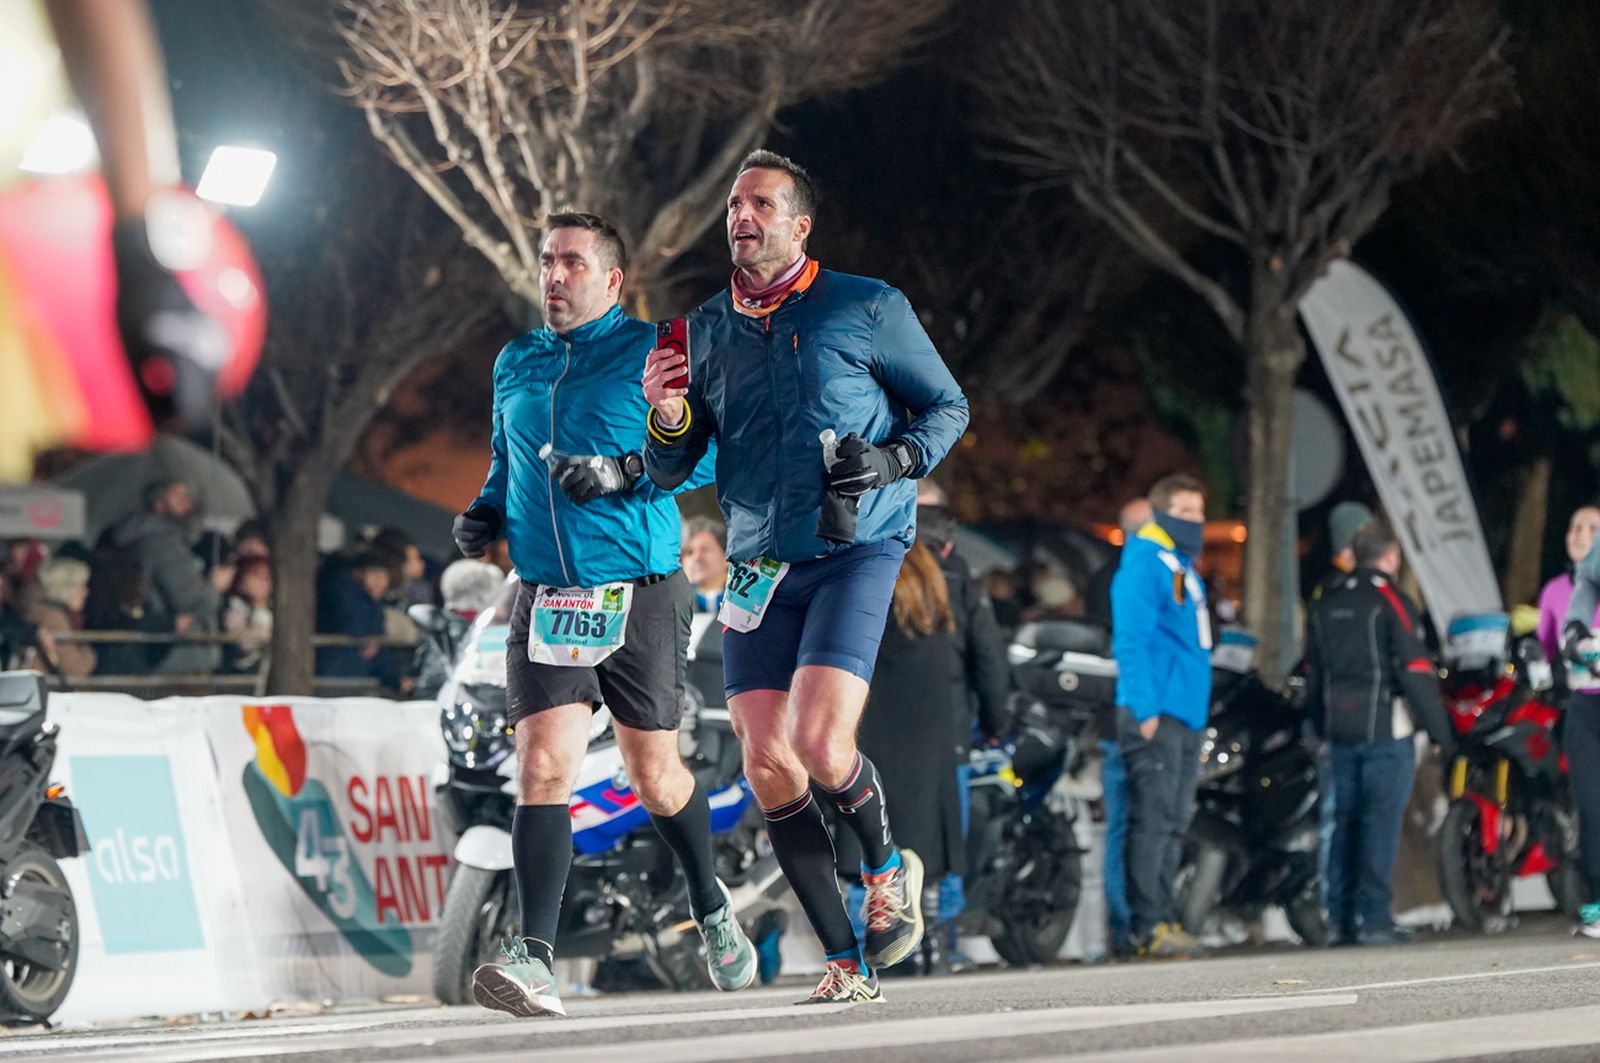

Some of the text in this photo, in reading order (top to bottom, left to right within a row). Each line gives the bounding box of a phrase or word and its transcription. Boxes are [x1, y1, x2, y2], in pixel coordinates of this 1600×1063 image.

[1367, 310, 1478, 546] JAPEMASA
[543, 599, 561, 608] SAN
[551, 610, 607, 638] 7763
[347, 776, 432, 844] SAN
[96, 827, 180, 882] alsa
[295, 808, 357, 920] 43
[375, 855, 448, 925] ANT
